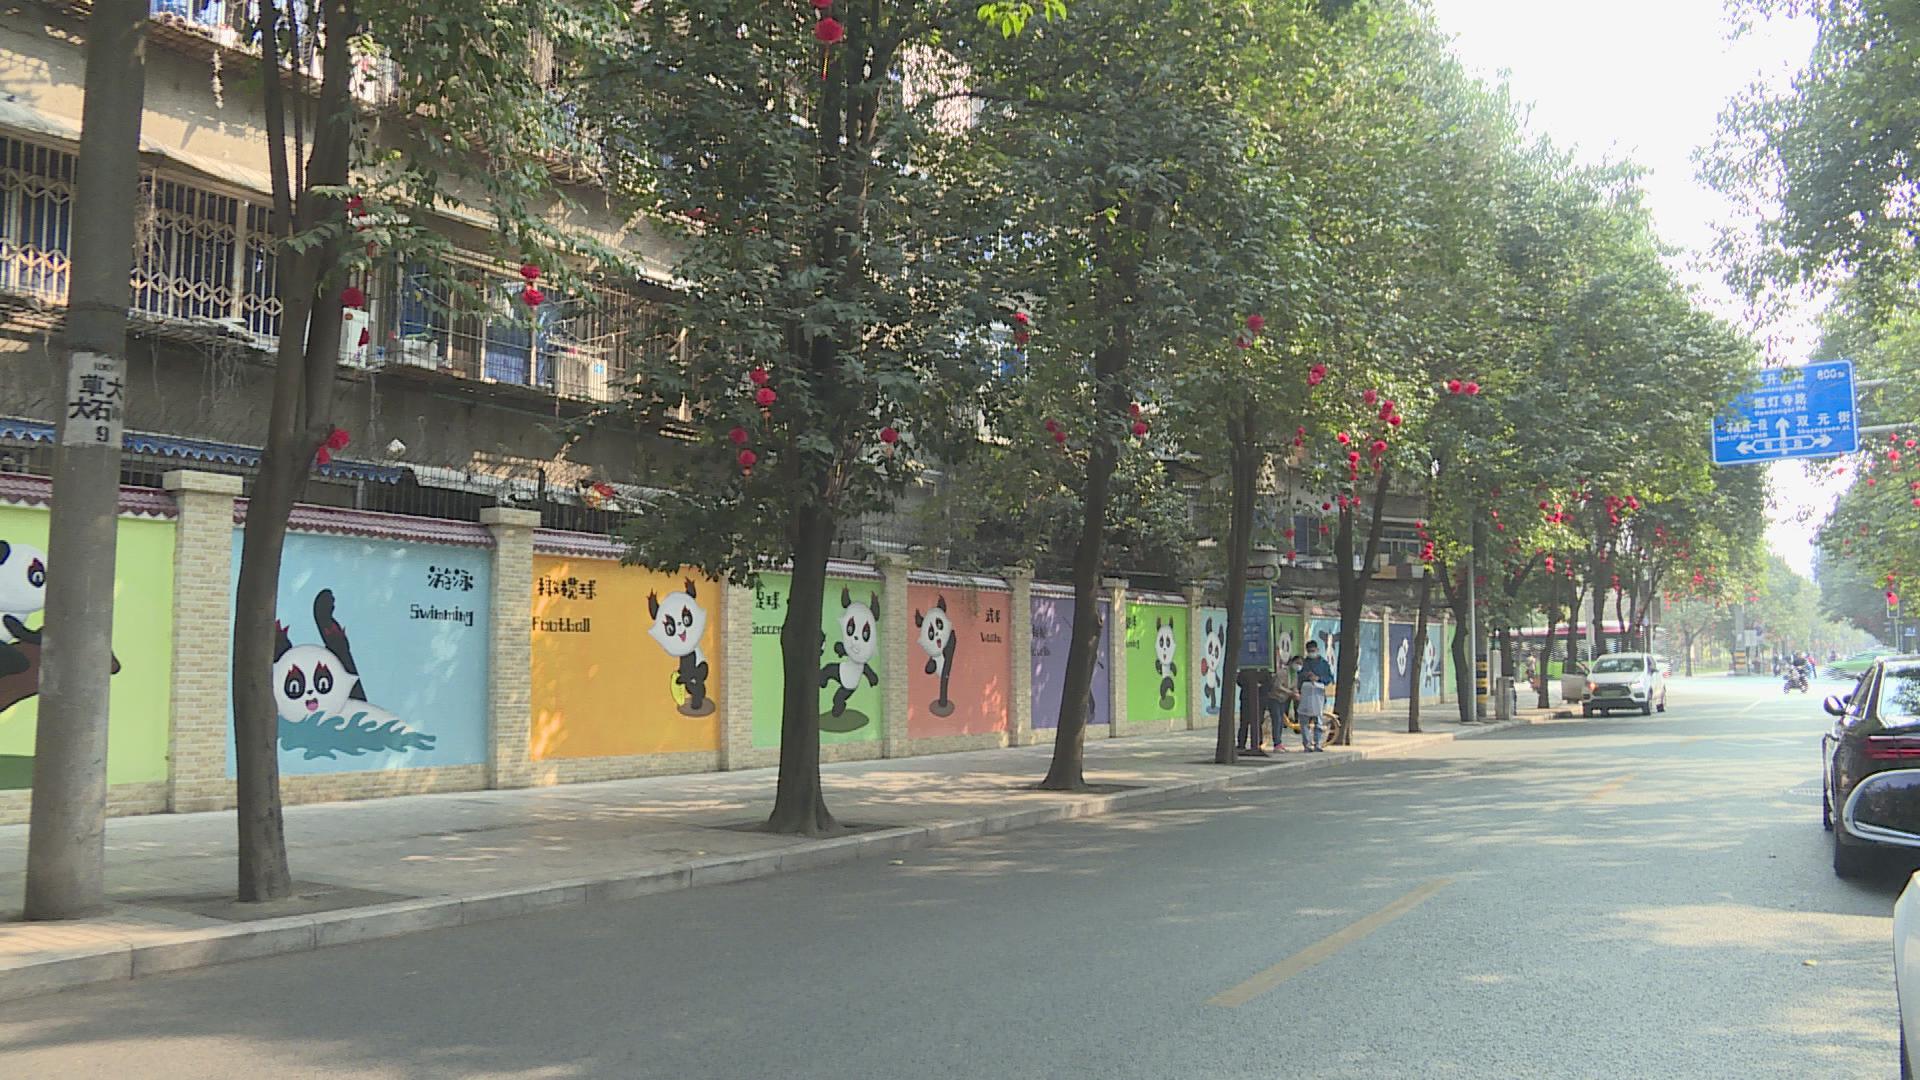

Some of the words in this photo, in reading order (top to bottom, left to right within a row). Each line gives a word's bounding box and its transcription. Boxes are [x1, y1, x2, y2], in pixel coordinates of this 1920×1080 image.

[96, 426, 110, 442] 9
[427, 565, 474, 592] 游泳
[410, 604, 474, 627] Swimming
[532, 615, 592, 633] Football
